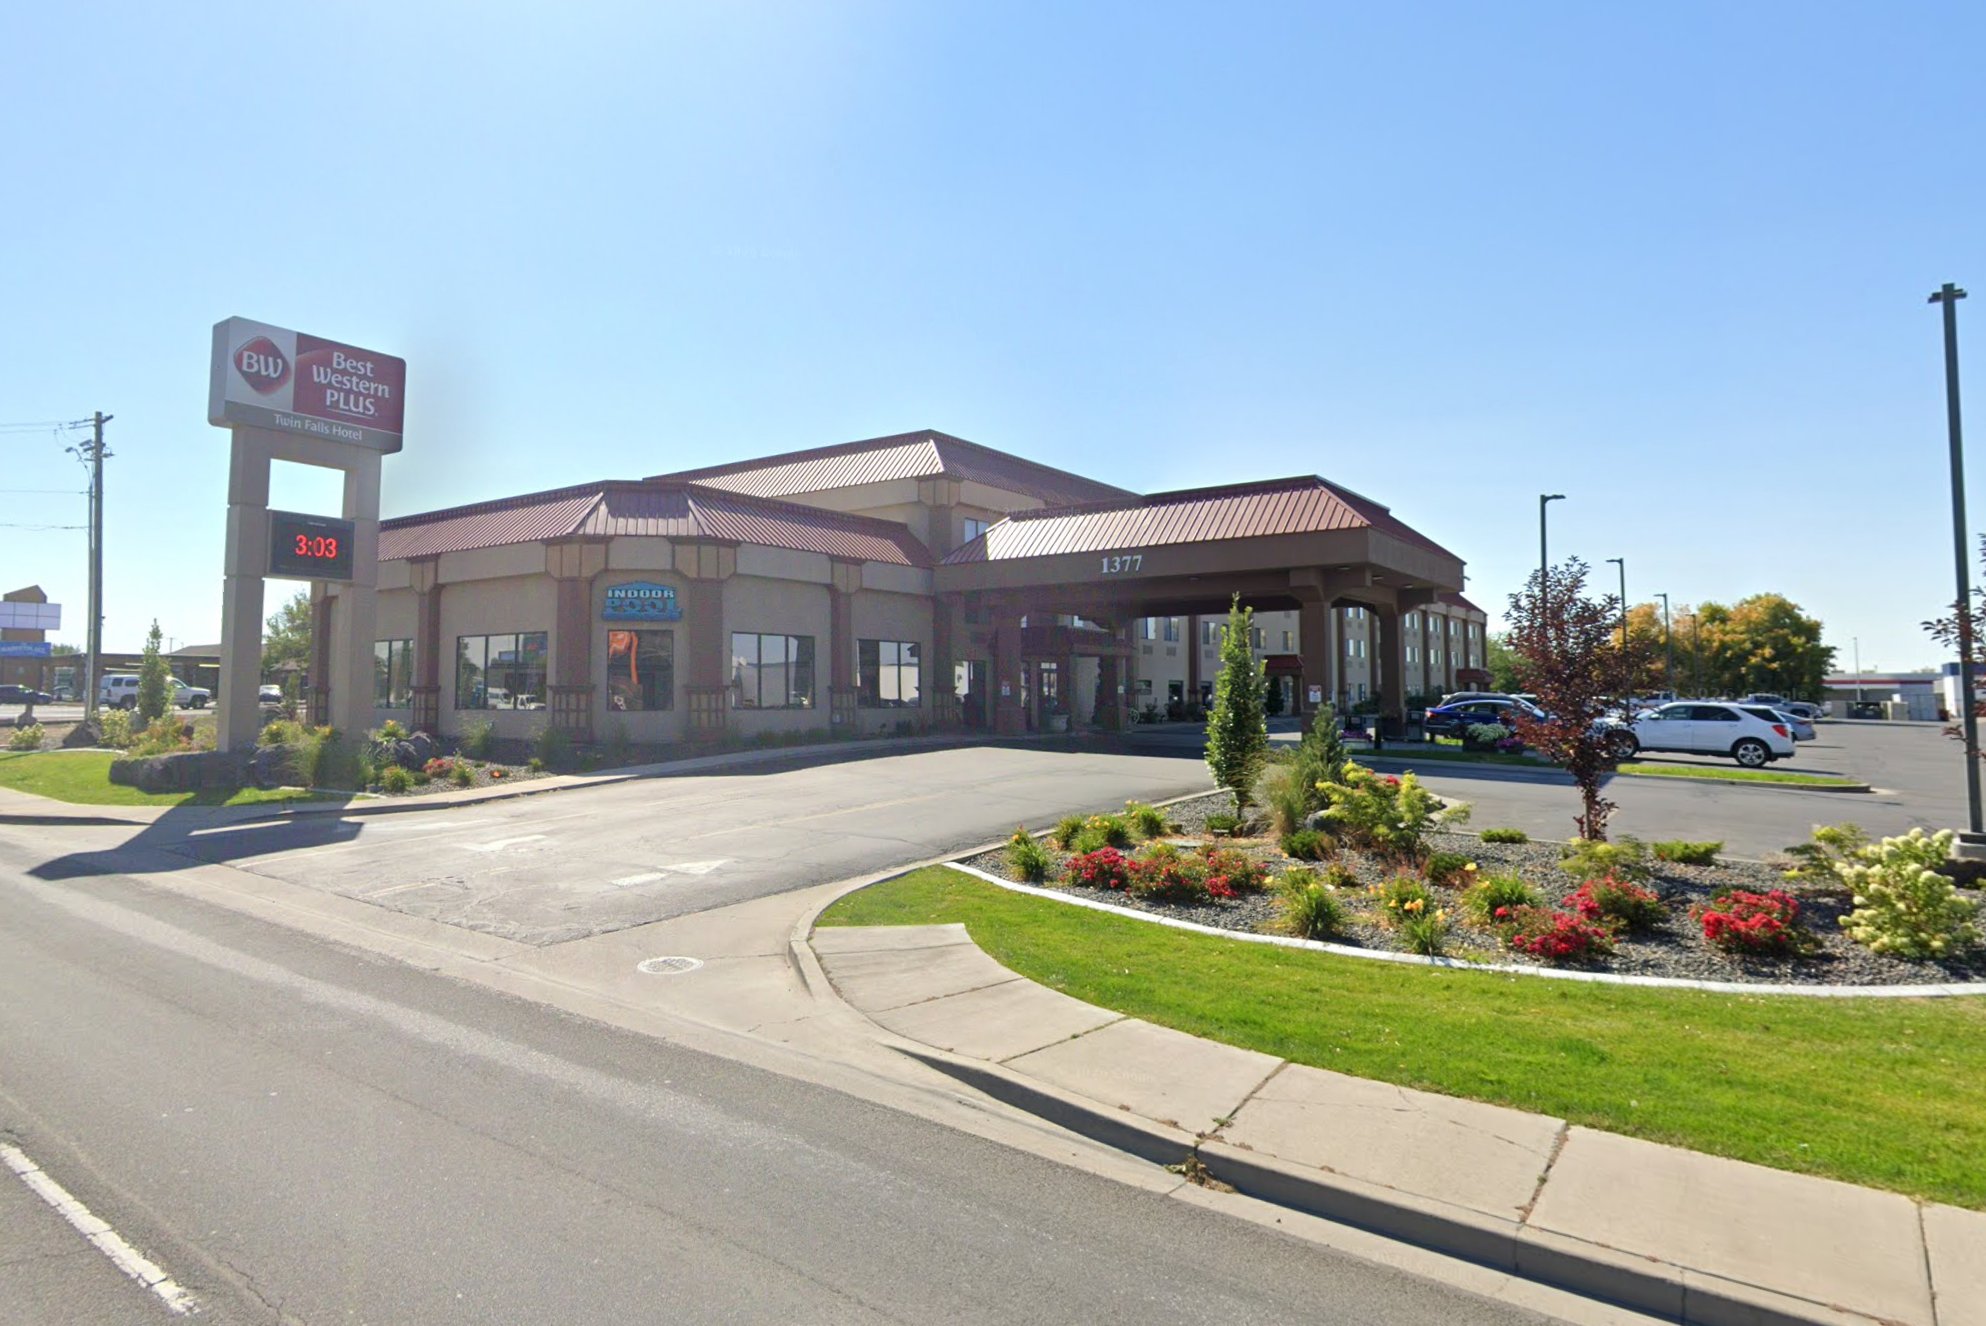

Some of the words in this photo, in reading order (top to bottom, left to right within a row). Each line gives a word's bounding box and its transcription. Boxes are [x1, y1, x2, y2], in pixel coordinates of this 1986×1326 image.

[241, 350, 283, 379] BW
[332, 351, 374, 377] Best
[312, 364, 390, 398] Western
[326, 388, 375, 416] PLUS
[273, 413, 301, 429] Twin
[304, 419, 330, 434] Falls
[332, 426, 363, 441] Hotel
[295, 534, 337, 558] 3:03
[1101, 555, 1143, 574] 1377
[607, 589, 674, 598] INDOOR
[605, 598, 681, 617] POOL
